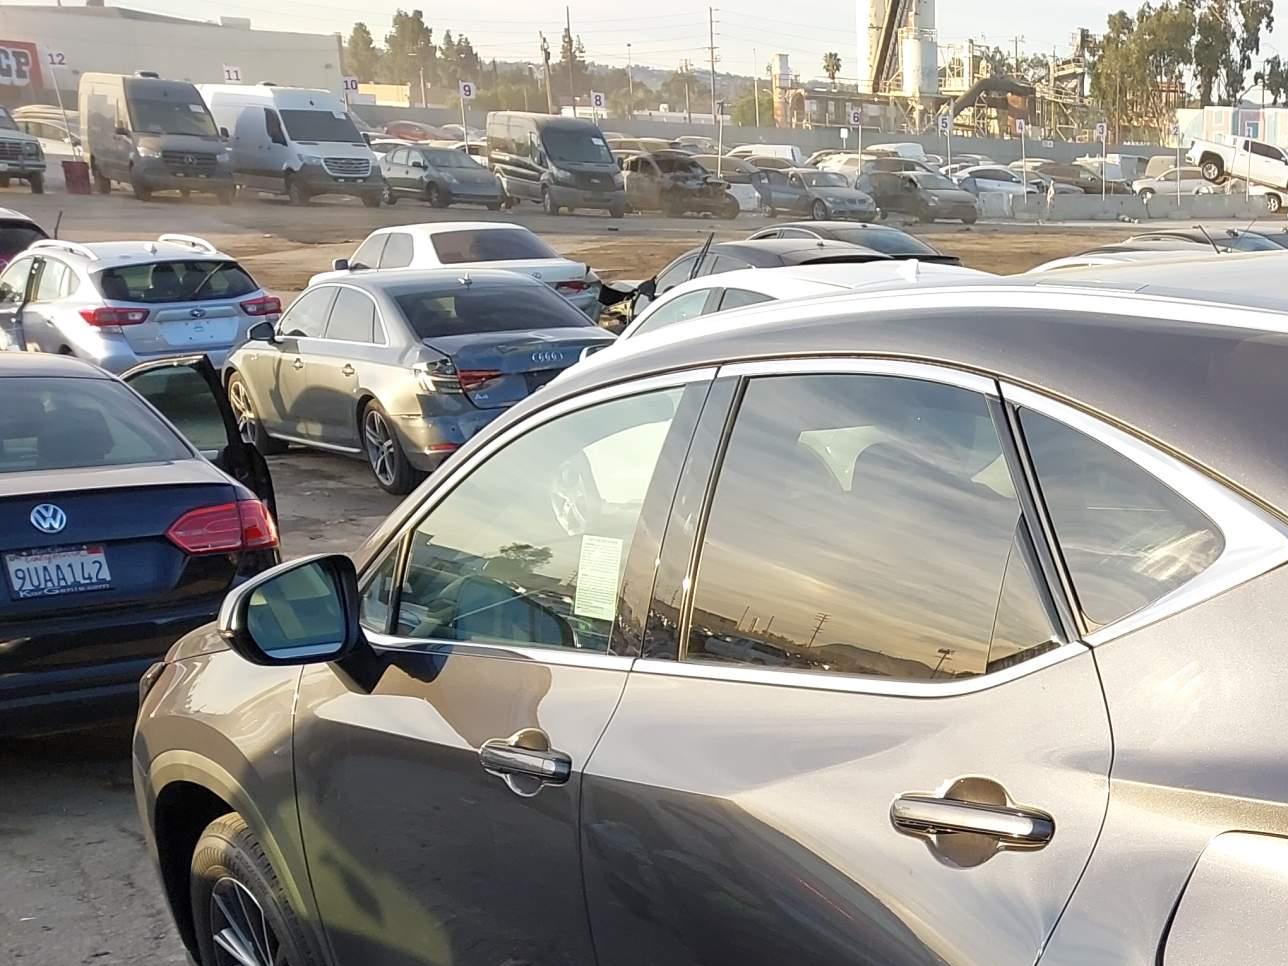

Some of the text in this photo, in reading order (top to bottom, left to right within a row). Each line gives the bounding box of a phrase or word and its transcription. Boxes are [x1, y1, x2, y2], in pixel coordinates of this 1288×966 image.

[47, 52, 66, 66] 12
[224, 69, 241, 81] 11
[343, 79, 359, 91] 10
[463, 84, 472, 97] 9
[594, 94, 602, 107] 8
[852, 111, 860, 123] 6
[941, 117, 948, 129] 5
[1098, 124, 1105, 135] 3
[14, 559, 107, 592] 9UAA142
